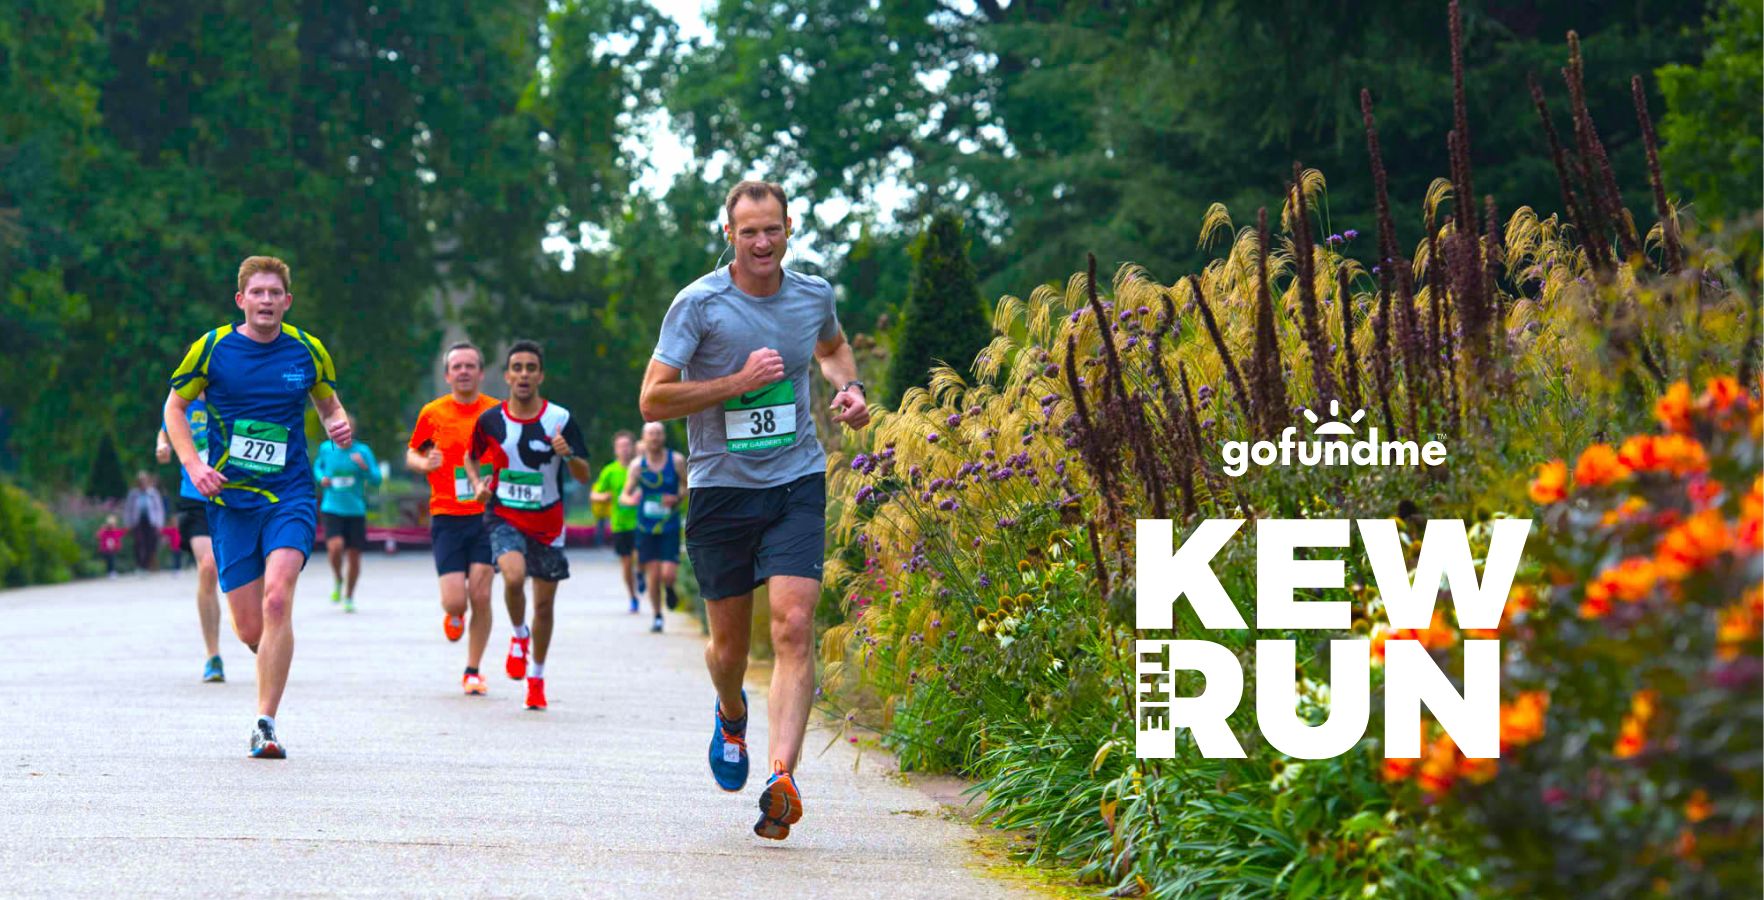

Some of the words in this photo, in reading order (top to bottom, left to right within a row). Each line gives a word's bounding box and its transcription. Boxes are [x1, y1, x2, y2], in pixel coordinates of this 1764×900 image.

[750, 409, 776, 435] 38
[242, 440, 275, 461] 279
[508, 484, 532, 498] 418
